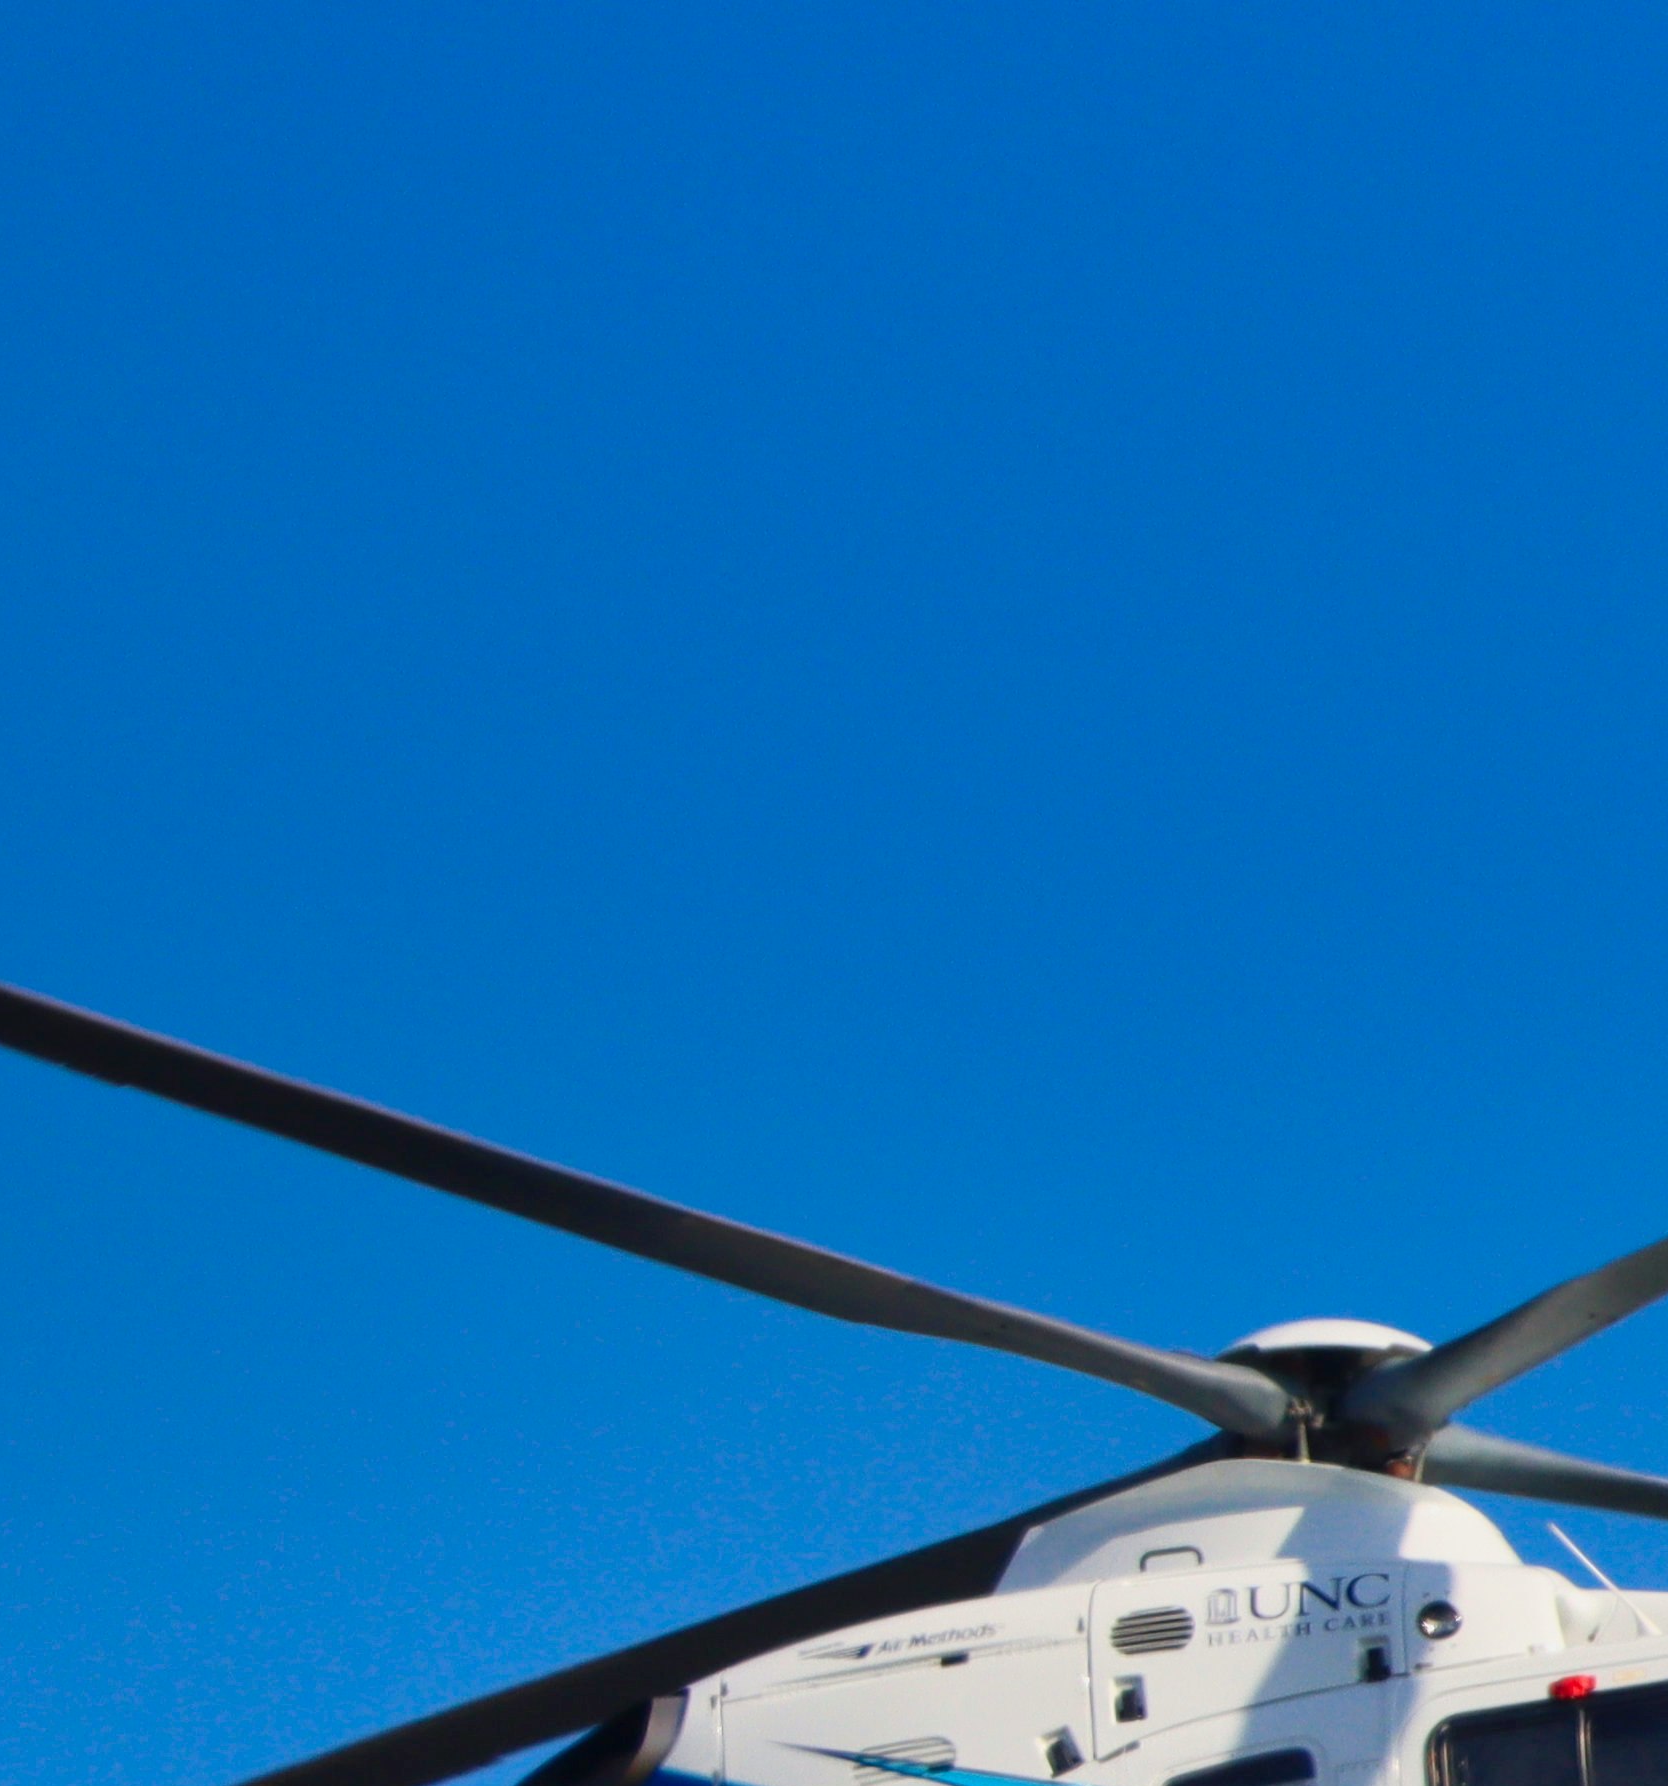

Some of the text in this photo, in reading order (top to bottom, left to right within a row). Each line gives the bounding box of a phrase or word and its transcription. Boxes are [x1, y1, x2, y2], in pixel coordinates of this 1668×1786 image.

[1248, 1573, 1391, 1620] UNC
[878, 1622, 998, 1655] Air Methods
[1207, 1612, 1391, 1646] HEALTH CARE
